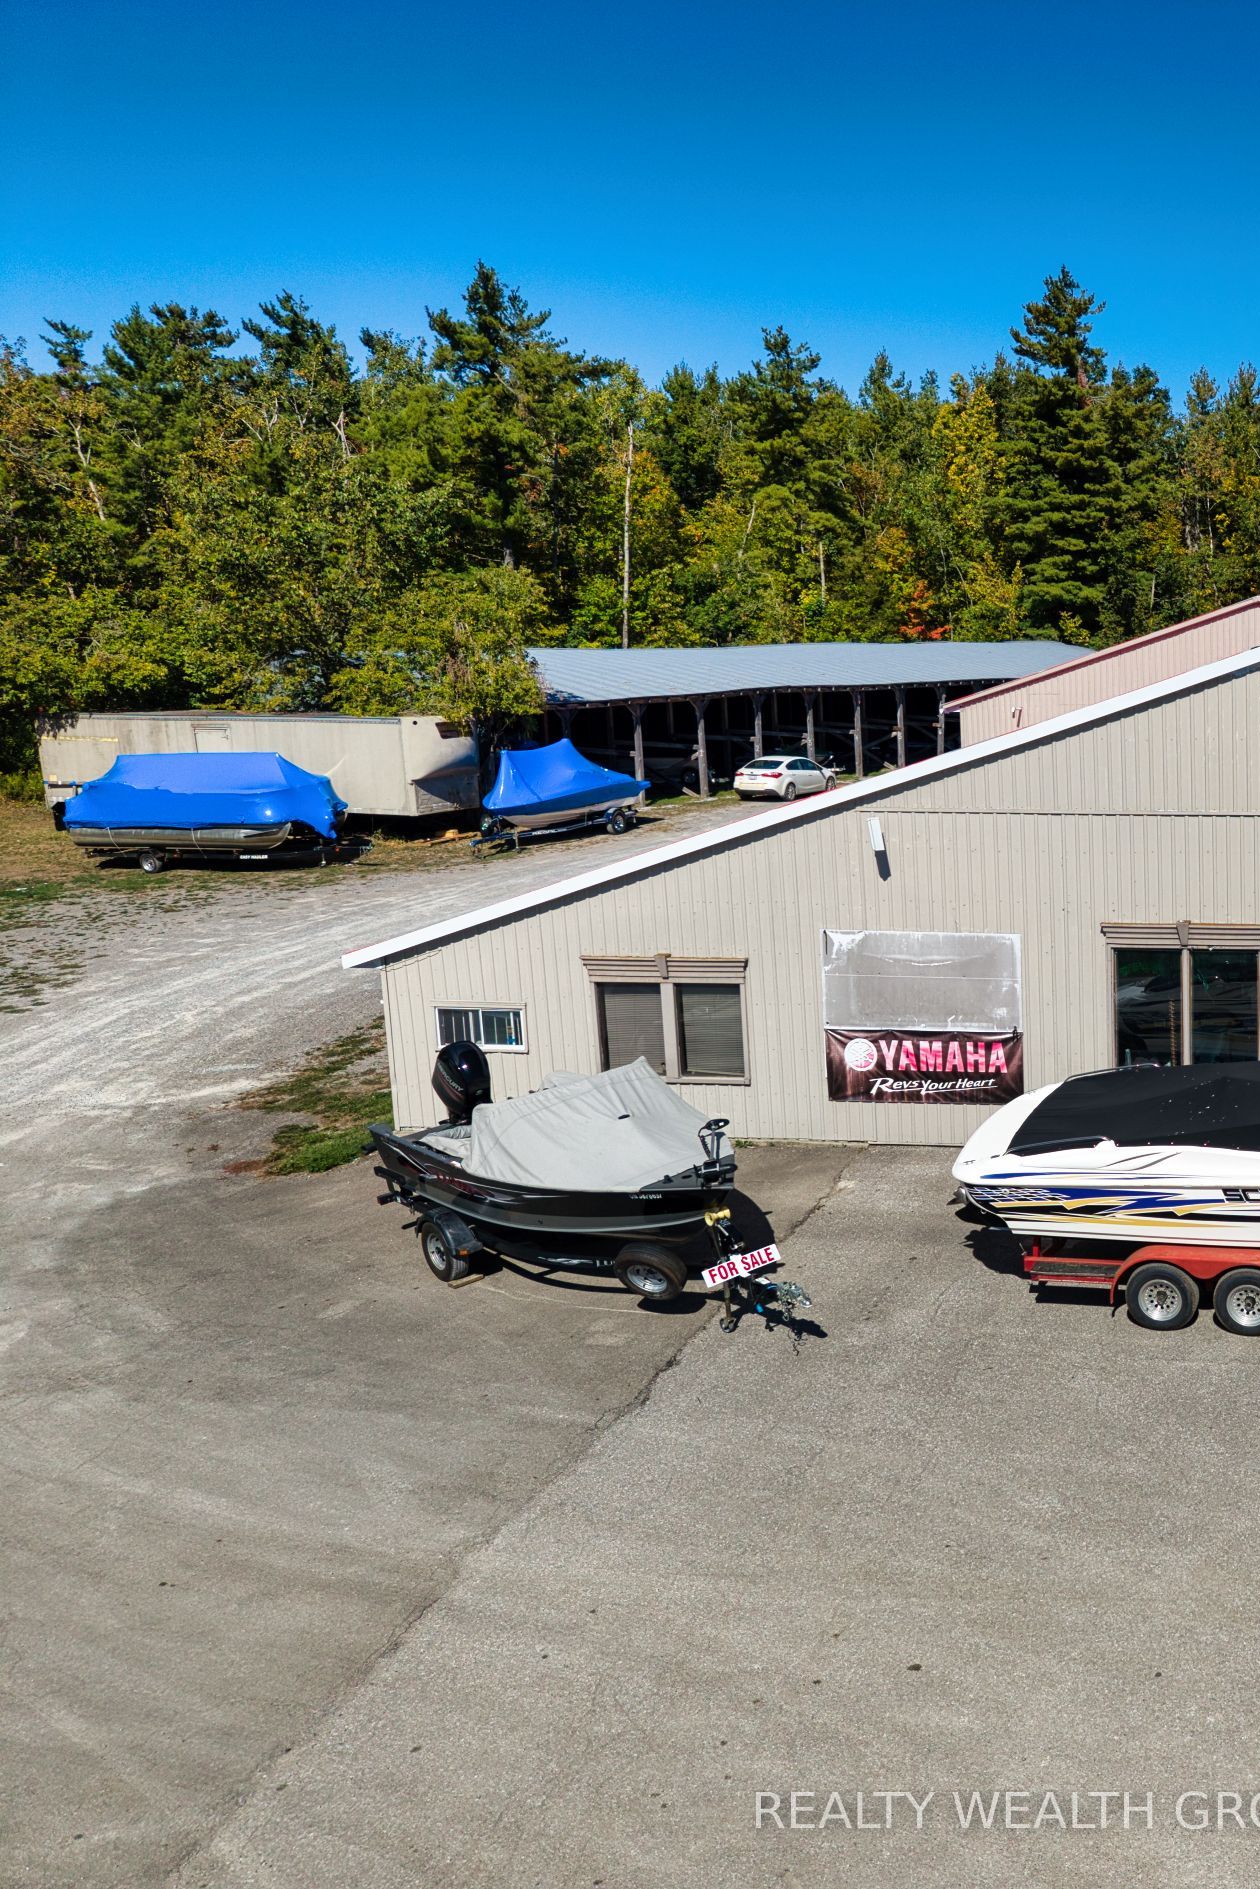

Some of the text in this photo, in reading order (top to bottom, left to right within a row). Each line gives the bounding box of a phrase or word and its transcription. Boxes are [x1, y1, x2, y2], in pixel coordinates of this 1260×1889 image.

[877, 1039, 1008, 1074] YAMAHA
[708, 1247, 775, 1284] FOR SALE
